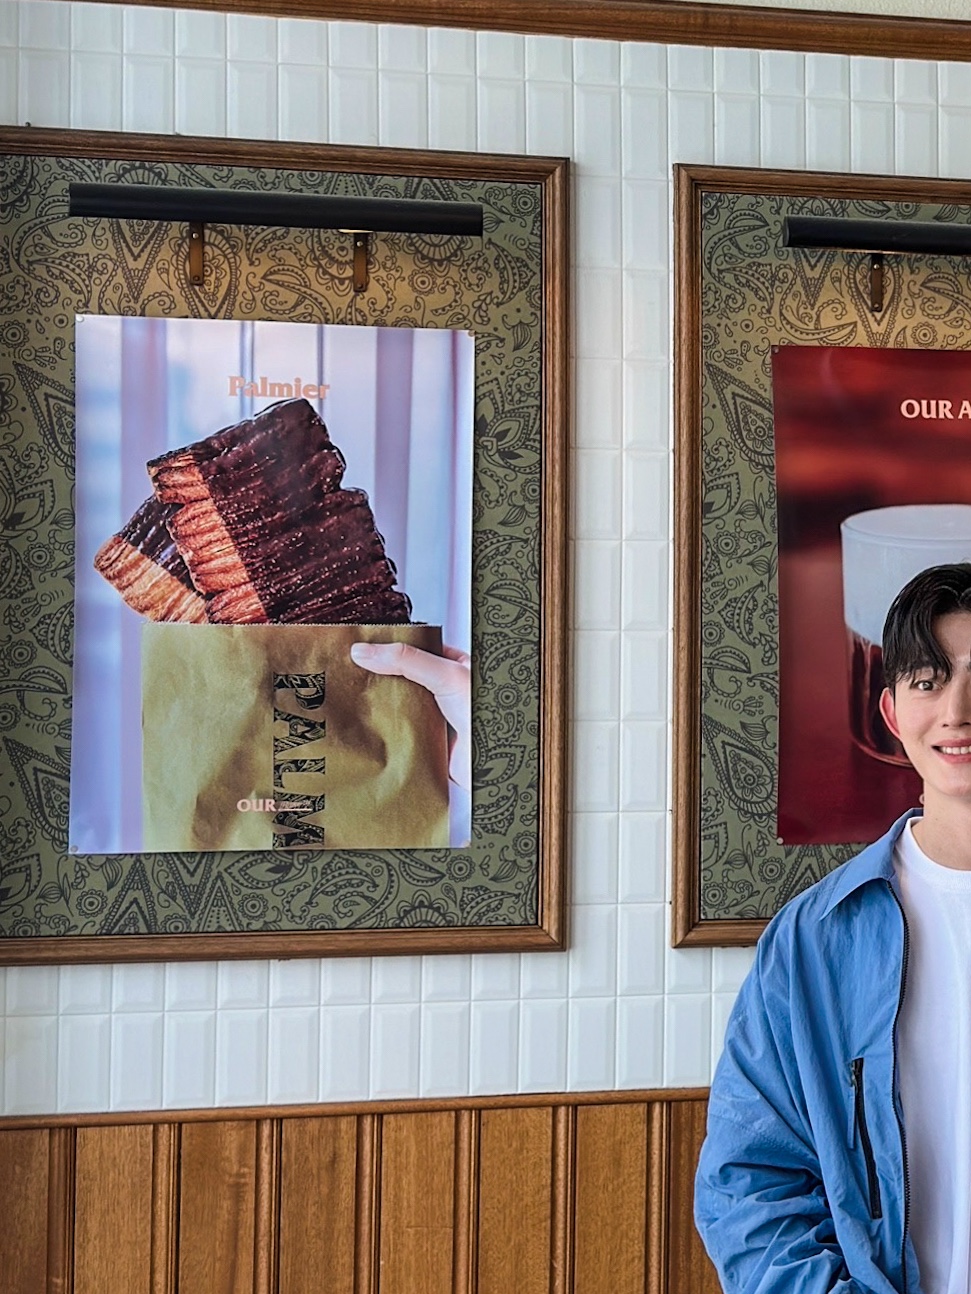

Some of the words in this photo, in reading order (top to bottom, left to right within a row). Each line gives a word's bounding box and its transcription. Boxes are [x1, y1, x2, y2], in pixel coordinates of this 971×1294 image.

[228, 376, 331, 400] Palmier
[900, 399, 954, 419] OUR
[272, 671, 326, 848] PALM
[236, 798, 277, 812] OUR
